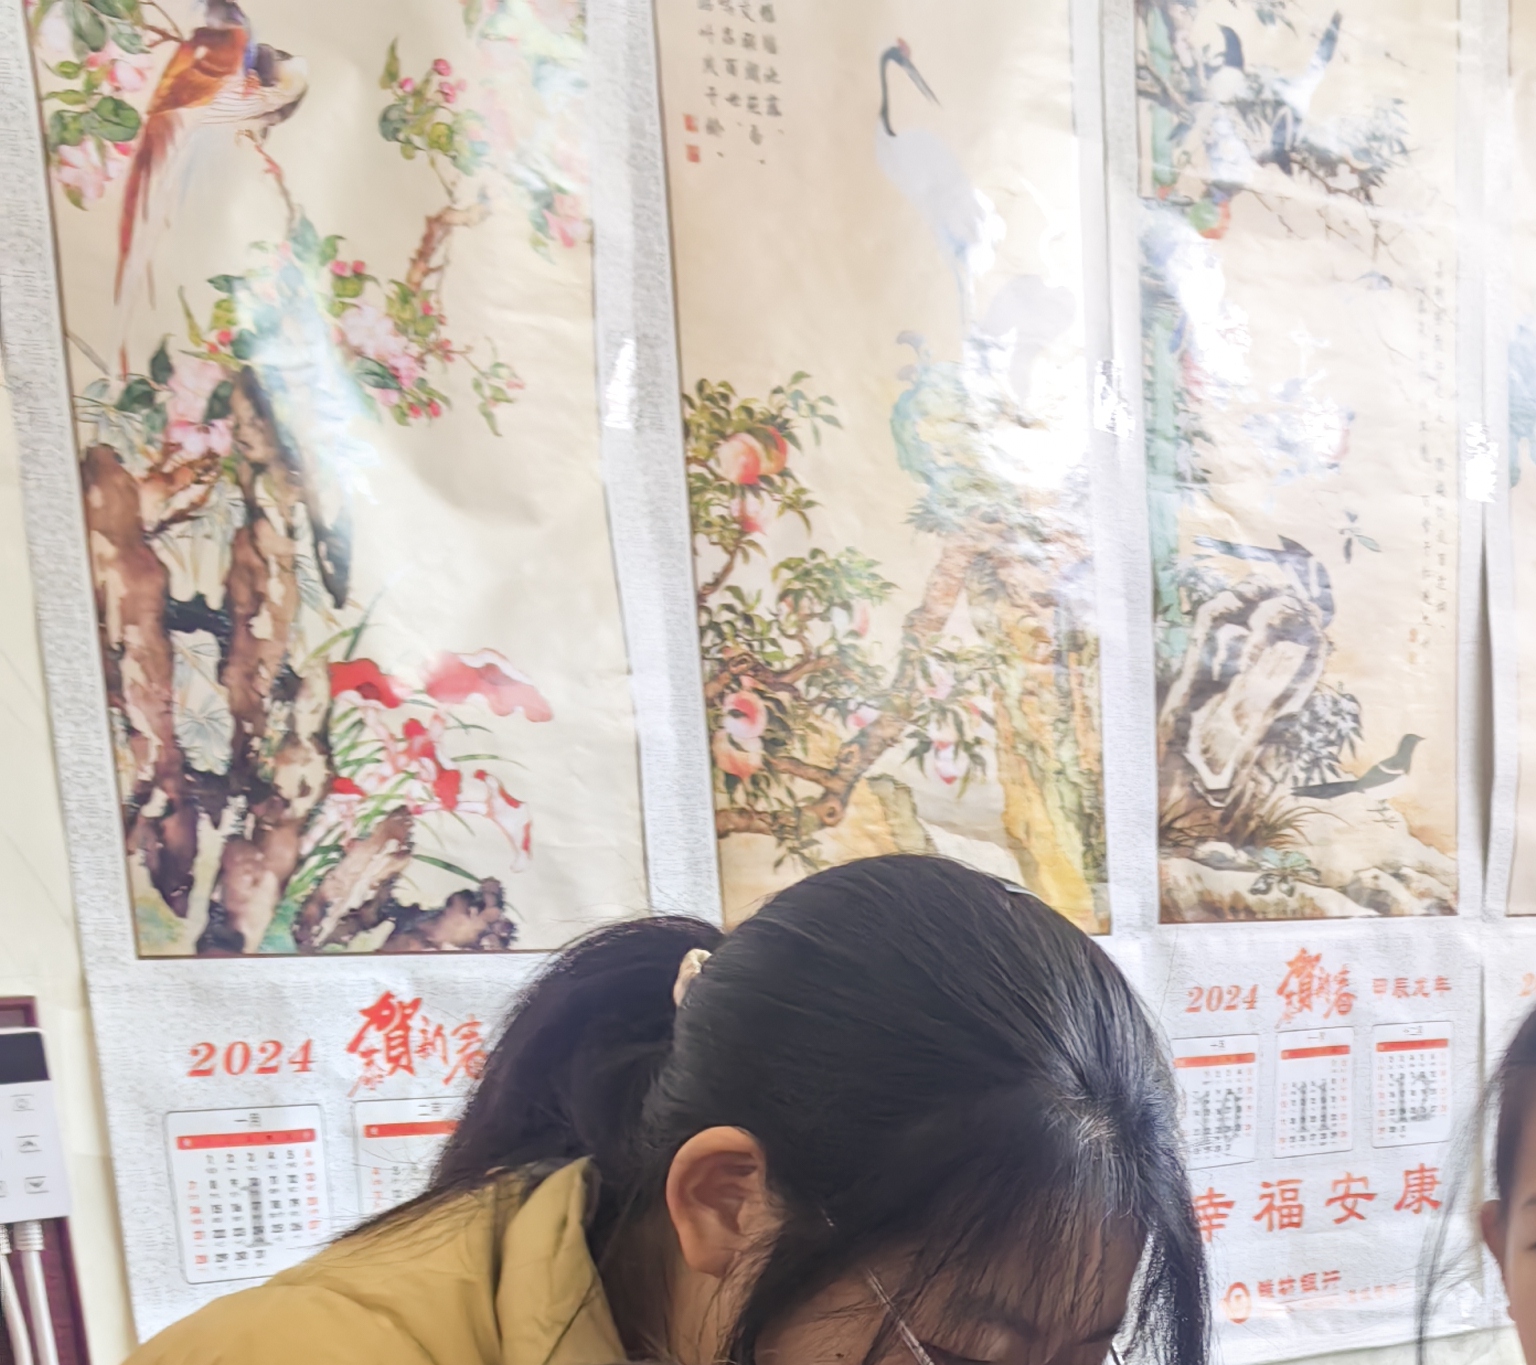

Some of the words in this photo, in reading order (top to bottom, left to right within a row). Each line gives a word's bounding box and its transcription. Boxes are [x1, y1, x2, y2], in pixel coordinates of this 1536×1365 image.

[1185, 983, 1259, 1014] 2024
[187, 1039, 314, 1077] 2024
[1193, 1163, 1442, 1243] 幸福安康
